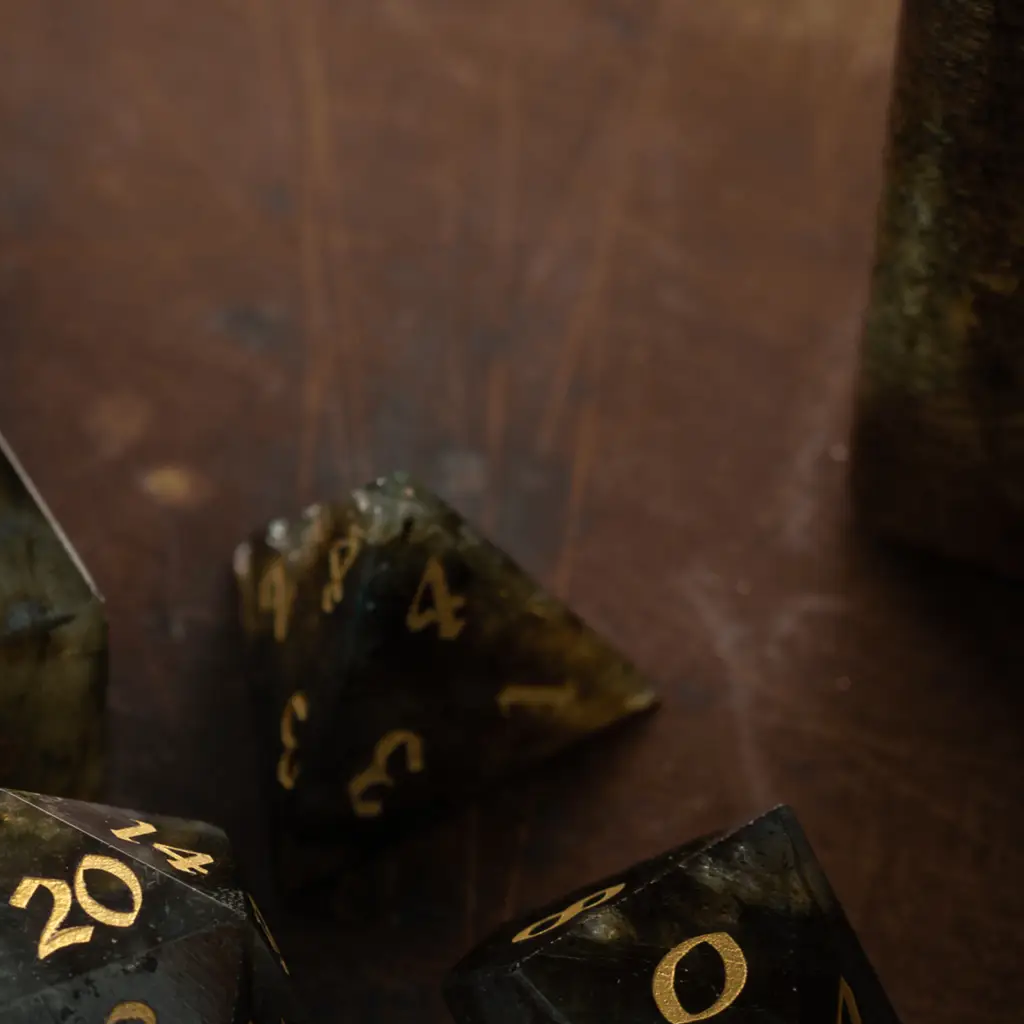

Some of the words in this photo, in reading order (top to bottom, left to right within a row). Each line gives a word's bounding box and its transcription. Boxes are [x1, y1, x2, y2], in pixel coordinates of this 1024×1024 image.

[406, 555, 467, 640] 4
[347, 727, 423, 818] 3
[111, 819, 214, 875] 14
[9, 854, 143, 960] 20
[512, 882, 626, 943] 8
[652, 931, 748, 1024] 0
